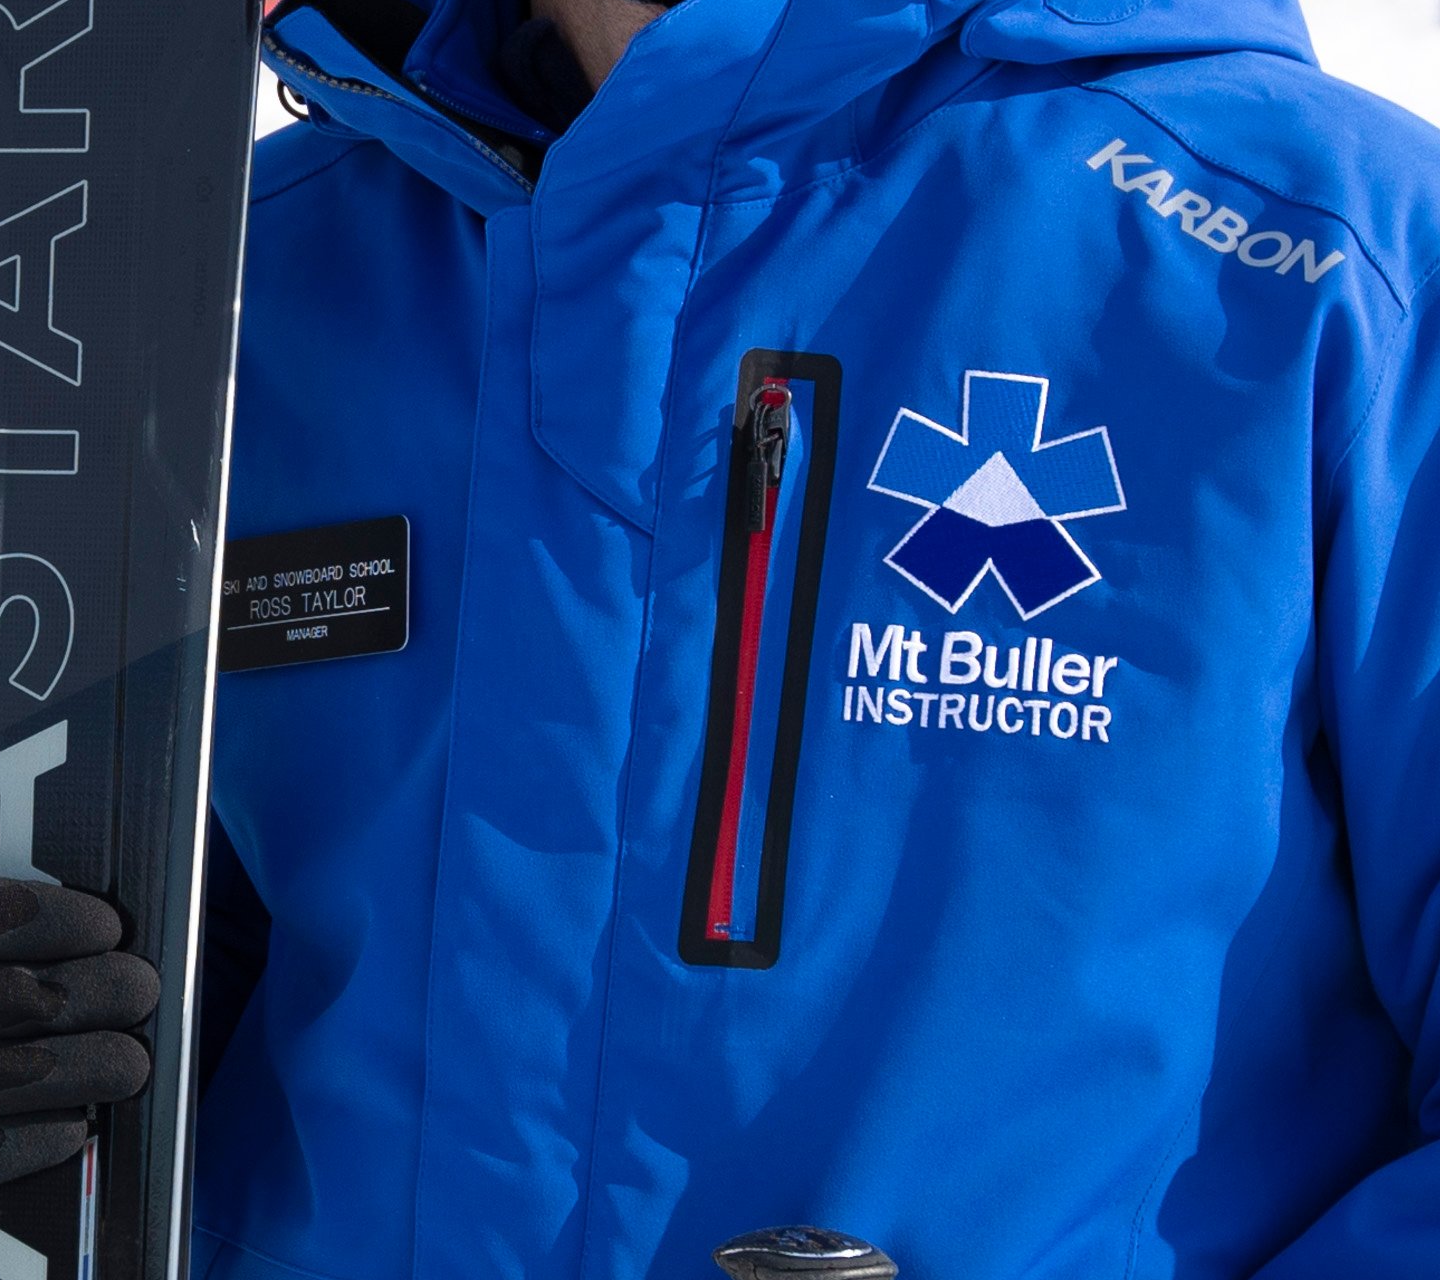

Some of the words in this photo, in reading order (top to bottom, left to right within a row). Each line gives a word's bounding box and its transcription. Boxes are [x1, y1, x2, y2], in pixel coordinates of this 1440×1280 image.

[1086, 138, 1346, 284] KARBON
[245, 575, 268, 593] AND
[273, 565, 344, 589] SNOWBOARD
[349, 558, 396, 579] SCHOOL
[250, 595, 292, 620] ROSS
[301, 585, 367, 613] TAYLOR
[286, 625, 329, 642] MANAGER
[847, 622, 928, 685] Mt
[939, 630, 1119, 698] Buller
[843, 685, 1113, 743] INSTRUCTOR
